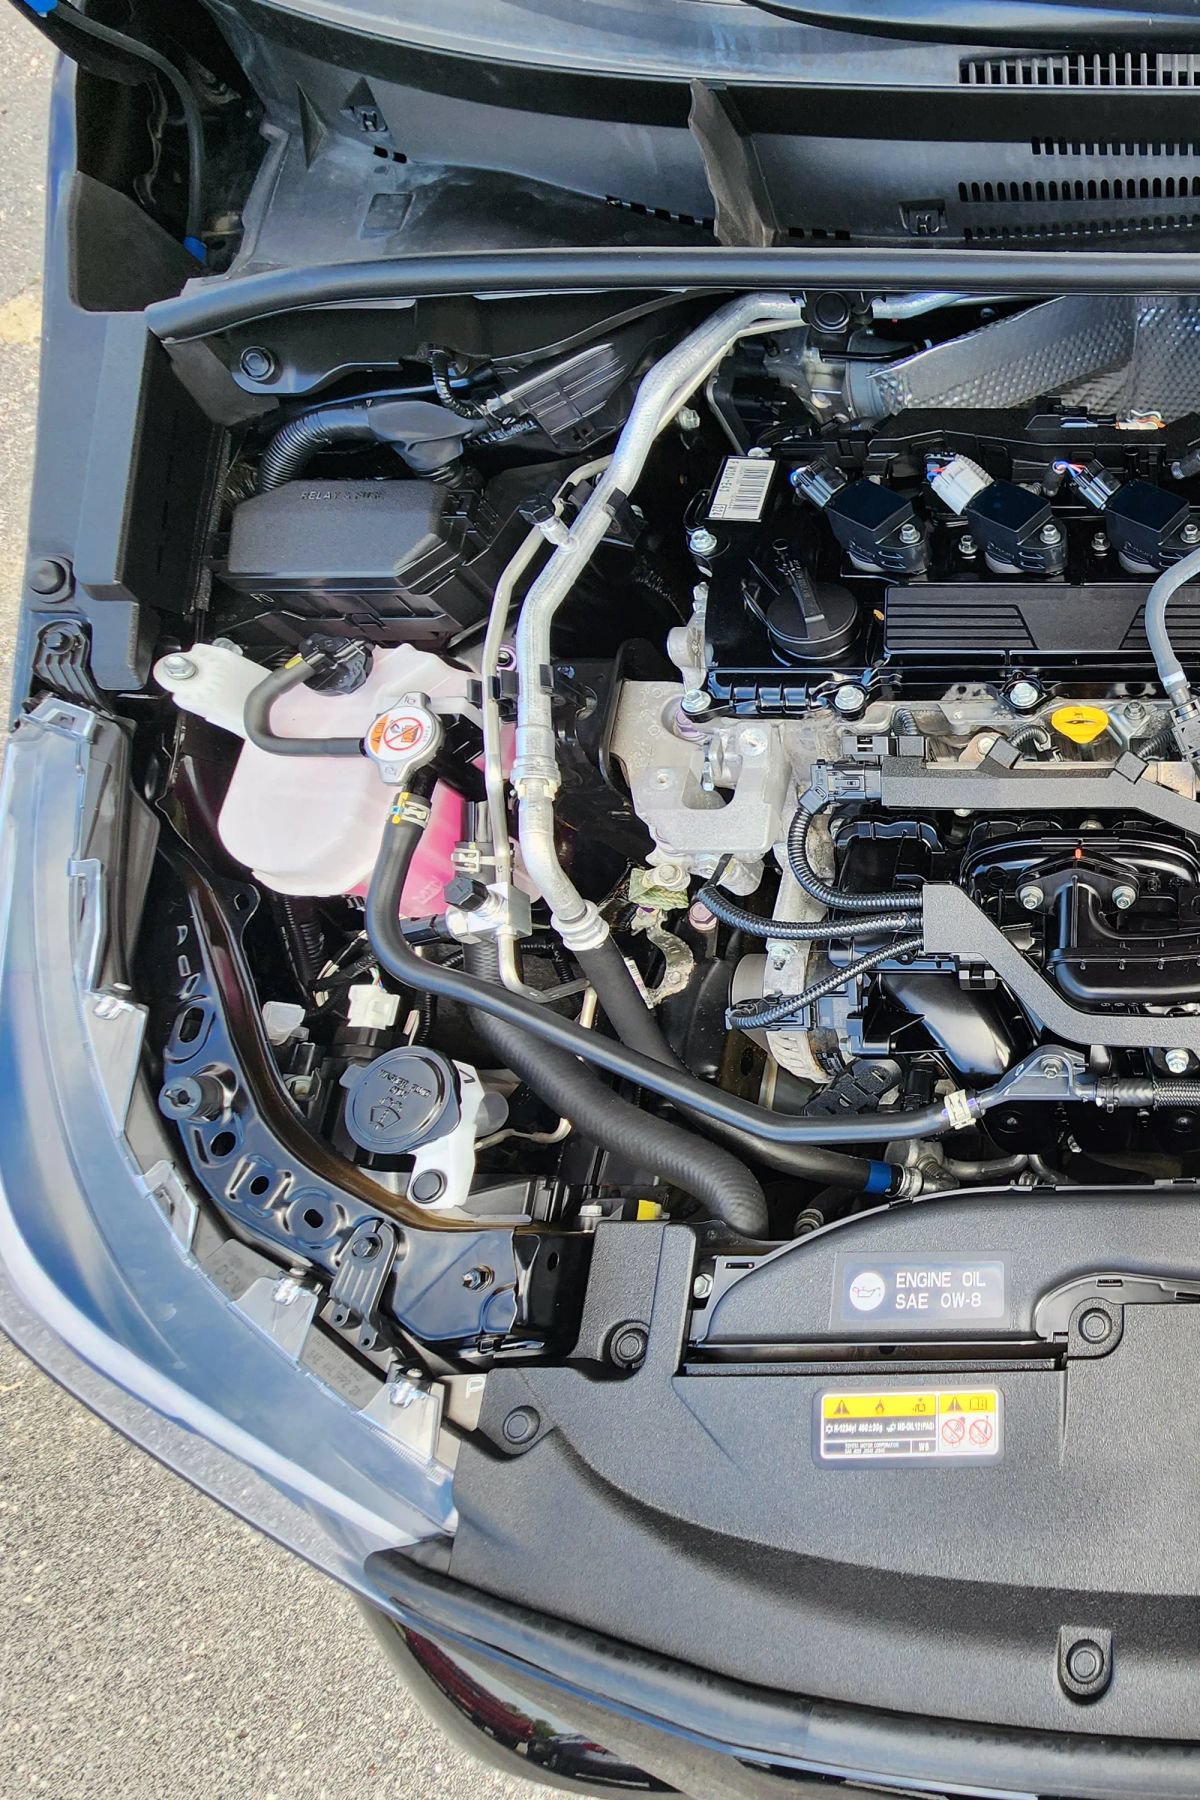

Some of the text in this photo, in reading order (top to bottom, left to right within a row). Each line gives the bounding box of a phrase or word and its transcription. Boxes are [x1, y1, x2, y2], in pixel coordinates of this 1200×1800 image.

[895, 1270, 986, 1288] ENGINE OIL
[895, 1292, 929, 1309] SAE
